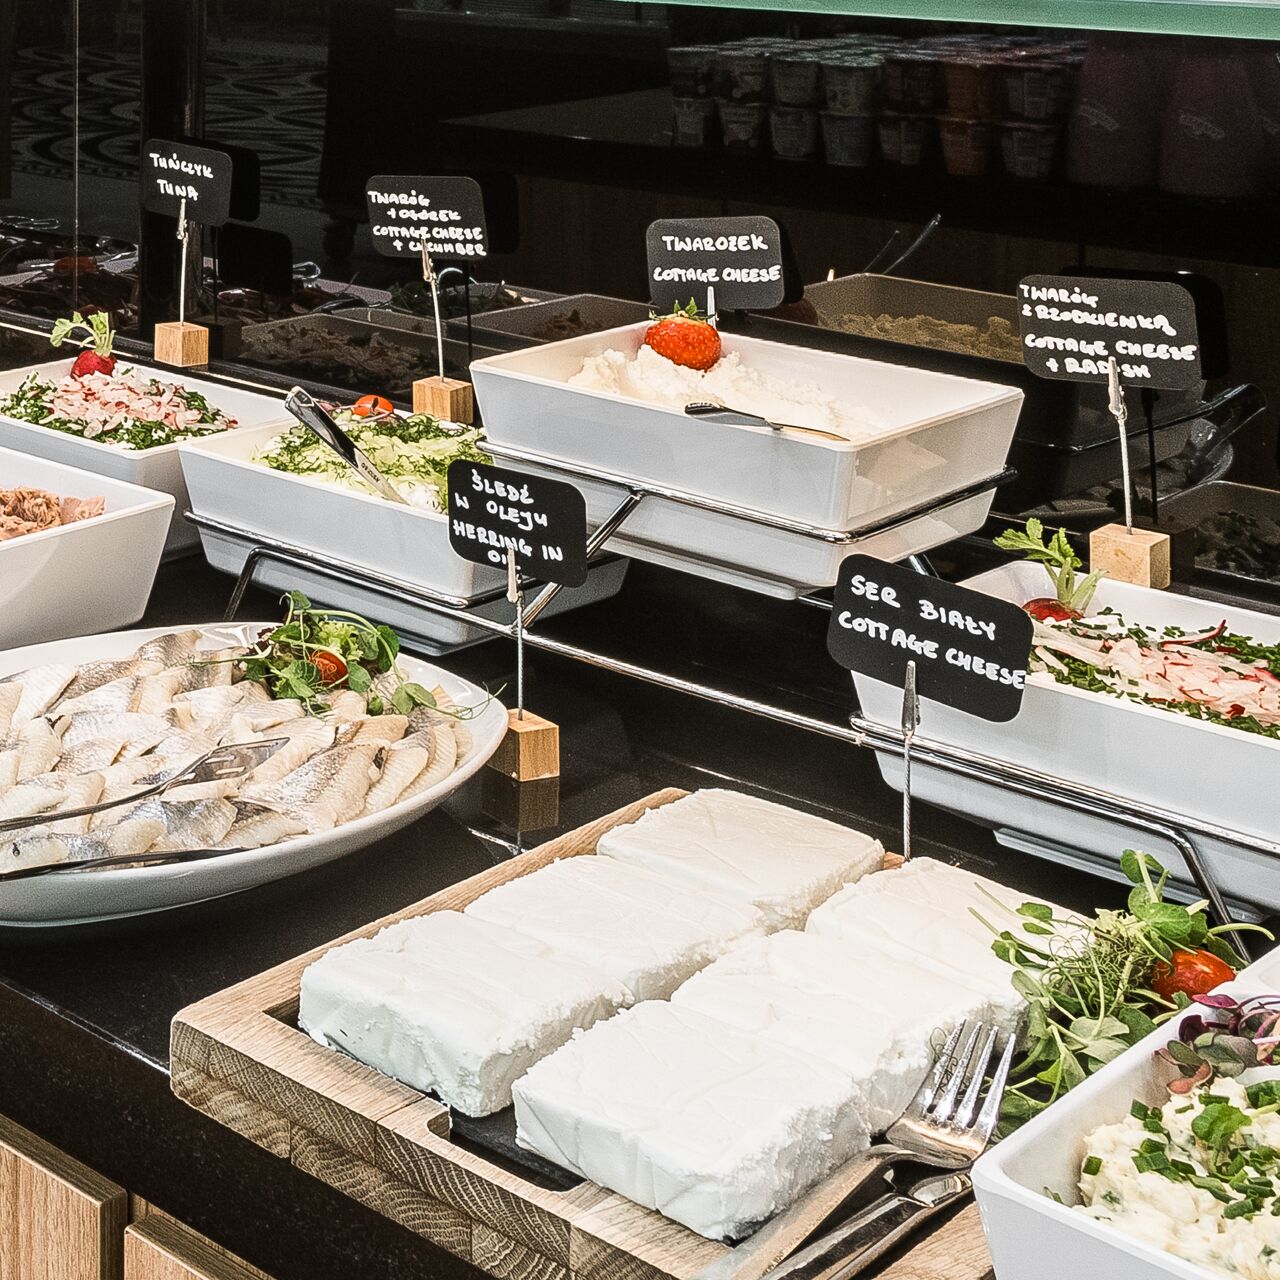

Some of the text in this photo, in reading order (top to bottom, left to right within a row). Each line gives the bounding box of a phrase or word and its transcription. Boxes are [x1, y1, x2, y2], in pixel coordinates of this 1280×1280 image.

[149, 152, 214, 178] TUŃCZYK
[156, 178, 199, 201] TUNA
[367, 189, 430, 207] TWARÓG
[372, 225, 483, 241] COTTAGE CHEESE
[653, 264, 781, 283] COTTAGE CHEESE
[1024, 333, 1197, 361] COTTAGE CHEESE
[1064, 357, 1151, 378] RADSH
[454, 492, 548, 531] W OLEJU
[452, 519, 563, 561] HERRING IN
[487, 549, 507, 565] OI
[851, 574, 996, 641] SER BIAŁY
[837, 610, 1026, 690] COTTAGE CHEESE
